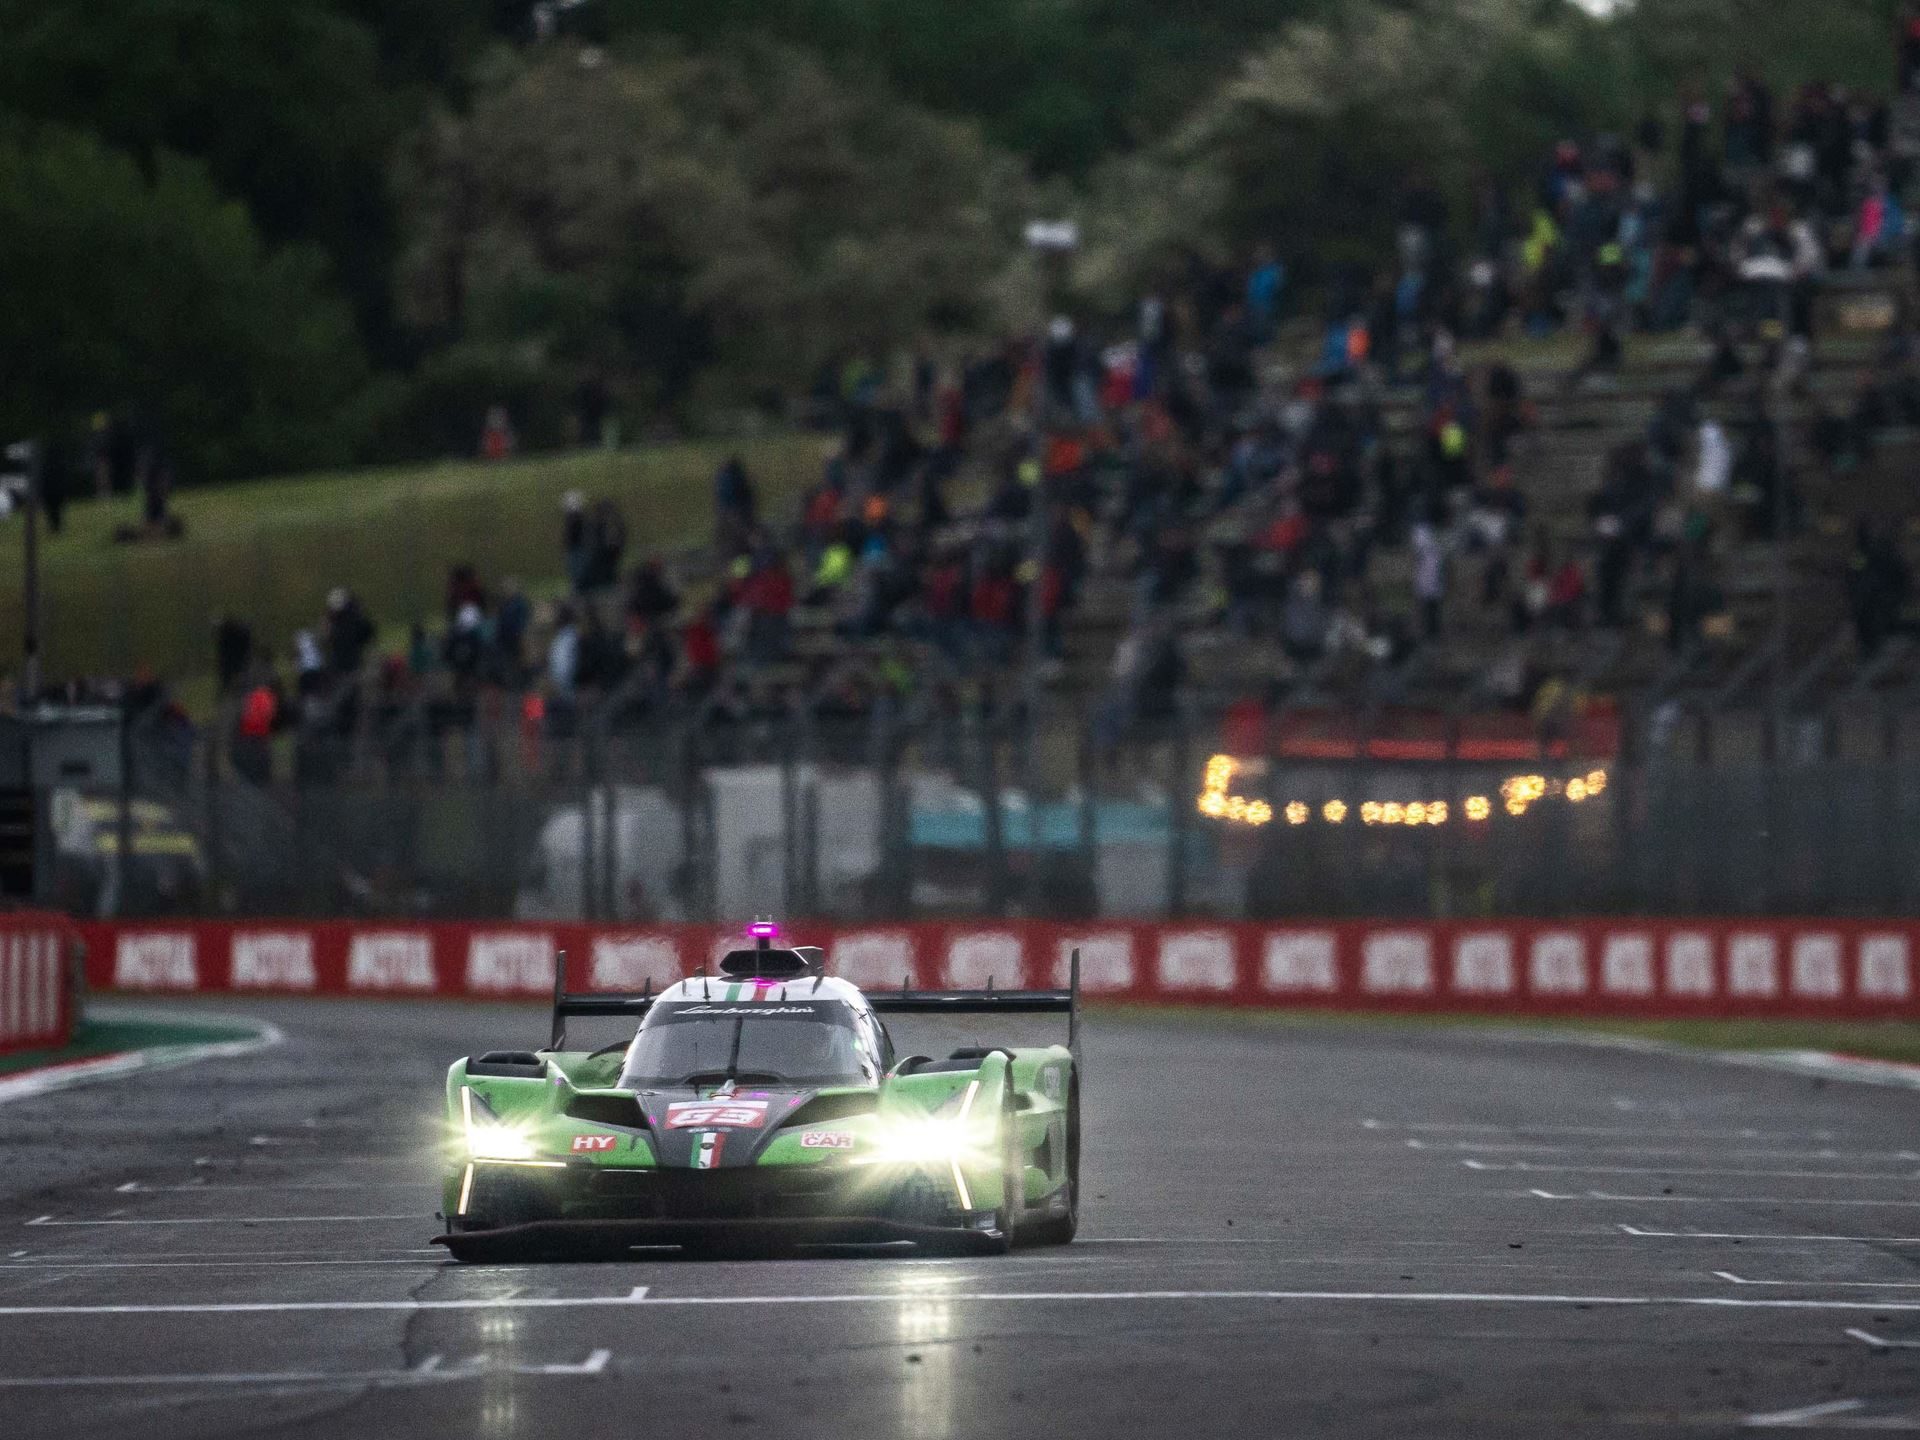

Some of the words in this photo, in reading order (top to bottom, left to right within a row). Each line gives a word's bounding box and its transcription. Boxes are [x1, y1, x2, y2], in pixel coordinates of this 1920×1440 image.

[673, 1005, 816, 1016] Lamborghini
[573, 1136, 616, 1149] HY
[803, 1137, 852, 1147] CAR
